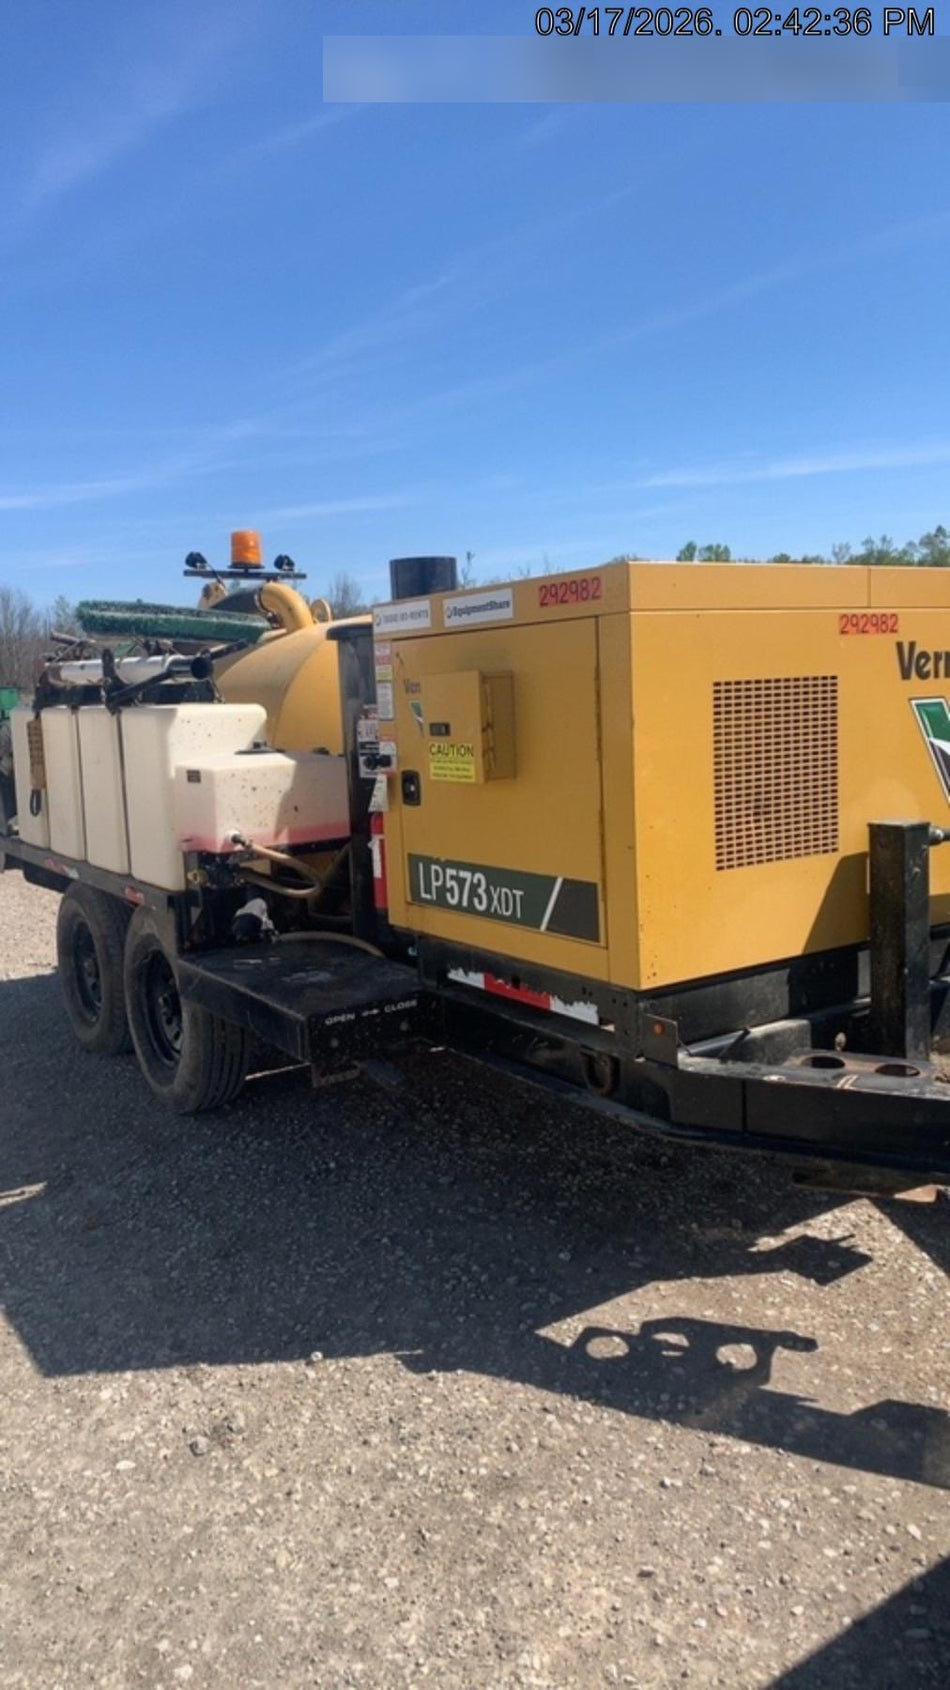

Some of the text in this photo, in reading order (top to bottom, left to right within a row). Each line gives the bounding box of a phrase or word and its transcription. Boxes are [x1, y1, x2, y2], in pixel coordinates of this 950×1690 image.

[539, 576, 602, 606] 292982
[453, 599, 511, 618] EquipmentShare
[840, 613, 898, 634] 292982
[896, 640, 950, 681] Ver
[430, 743, 474, 758] CAUTION
[325, 1013, 355, 1026] OPEN
